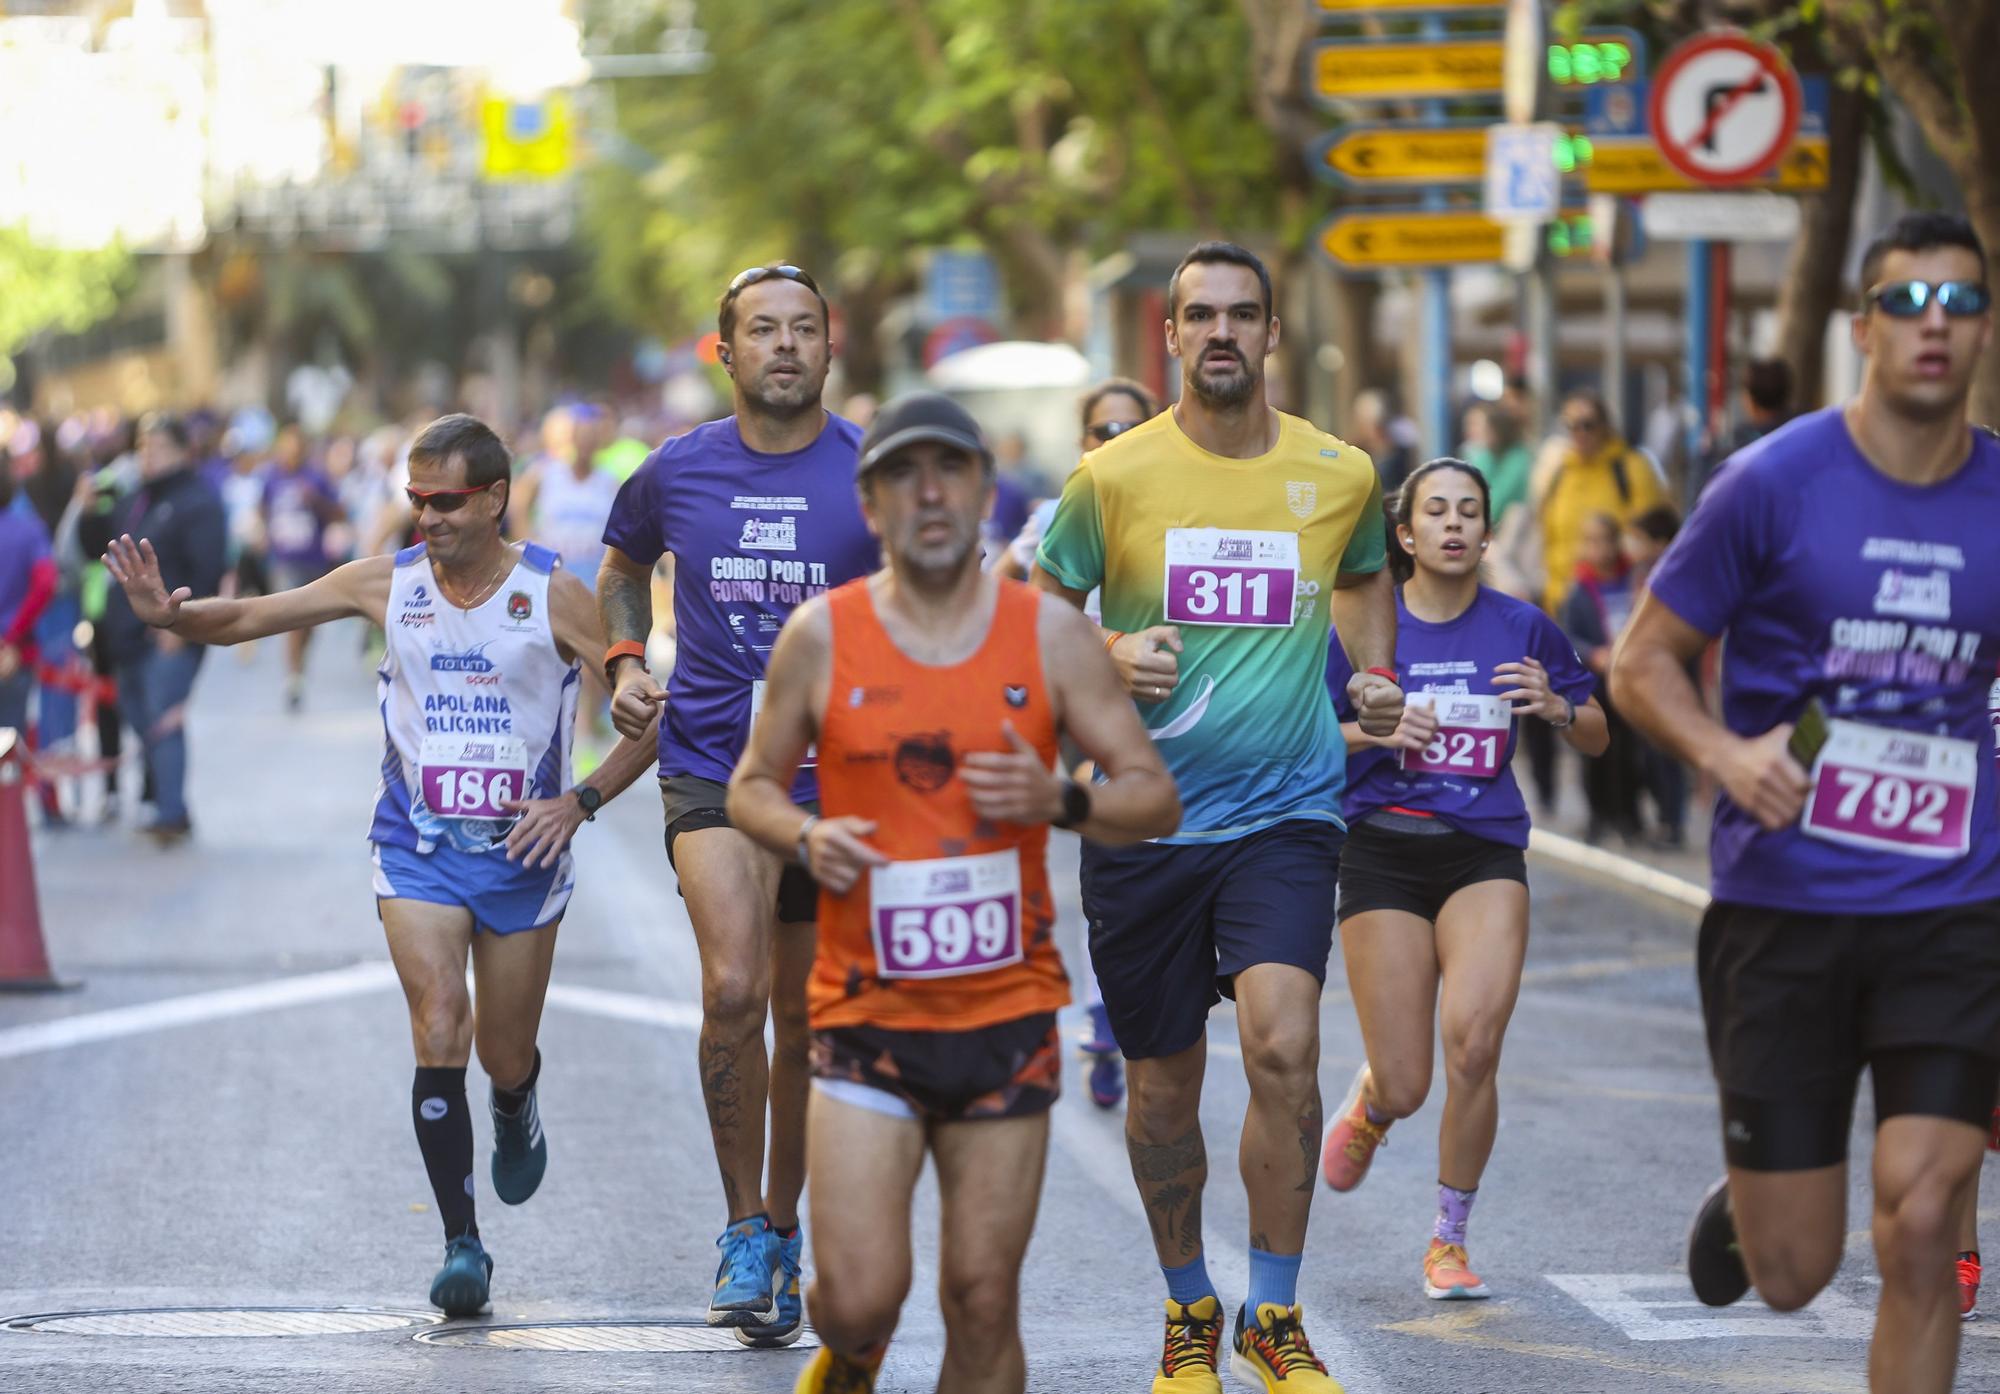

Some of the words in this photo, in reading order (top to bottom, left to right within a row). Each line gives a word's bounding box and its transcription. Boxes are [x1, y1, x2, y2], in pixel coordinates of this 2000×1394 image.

[711, 557, 767, 580] CORRO
[771, 560, 805, 583] POR
[709, 580, 765, 602] CORRO
[769, 582, 802, 604] POR
[1186, 570, 1269, 616] 311
[426, 716, 511, 734] ALICANTE
[1422, 732, 1497, 768] 821
[436, 770, 512, 811] 186
[1836, 770, 1949, 834] 792
[892, 900, 1009, 966] 599
